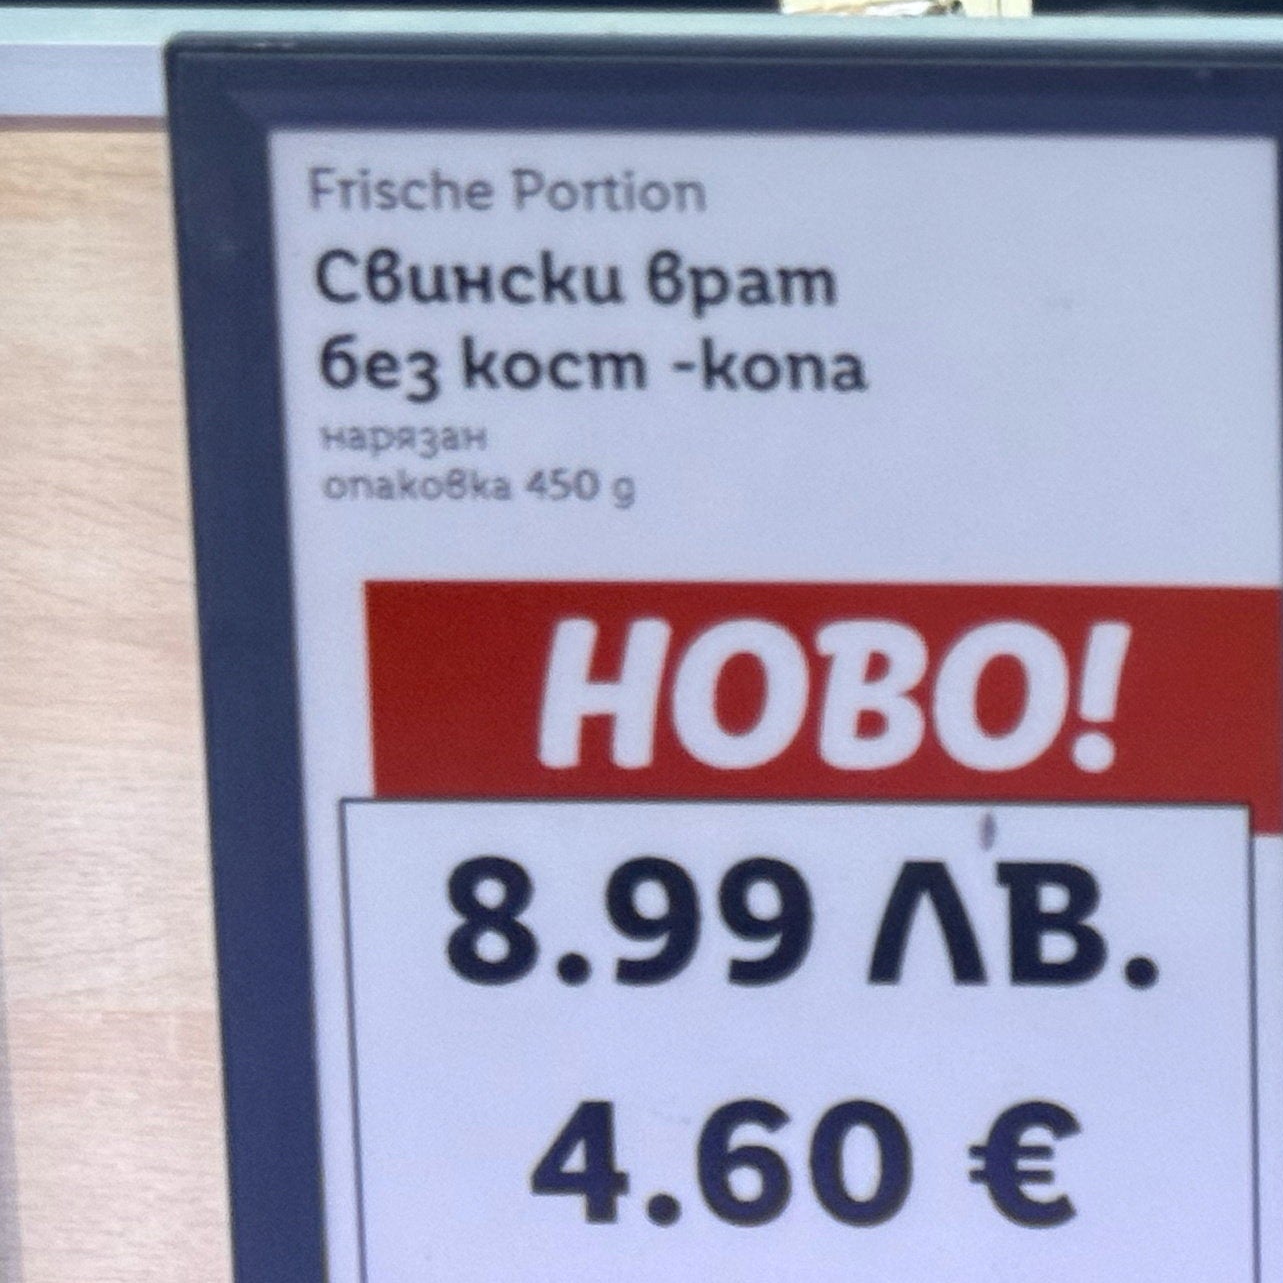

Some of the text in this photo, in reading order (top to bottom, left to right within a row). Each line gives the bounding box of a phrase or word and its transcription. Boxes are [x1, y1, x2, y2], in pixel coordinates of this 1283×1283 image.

[307, 164, 707, 214] Frische Portion
[315, 247, 837, 320] Свински врат
[319, 333, 869, 405] без кост -копа
[319, 425, 488, 460] нарязан
[322, 467, 637, 511] опаковка 450 g
[538, 617, 1132, 774] НОВО!
[446, 856, 1160, 990] 8.99 ЛВ.
[530, 1098, 1082, 1230] 4.60 €
